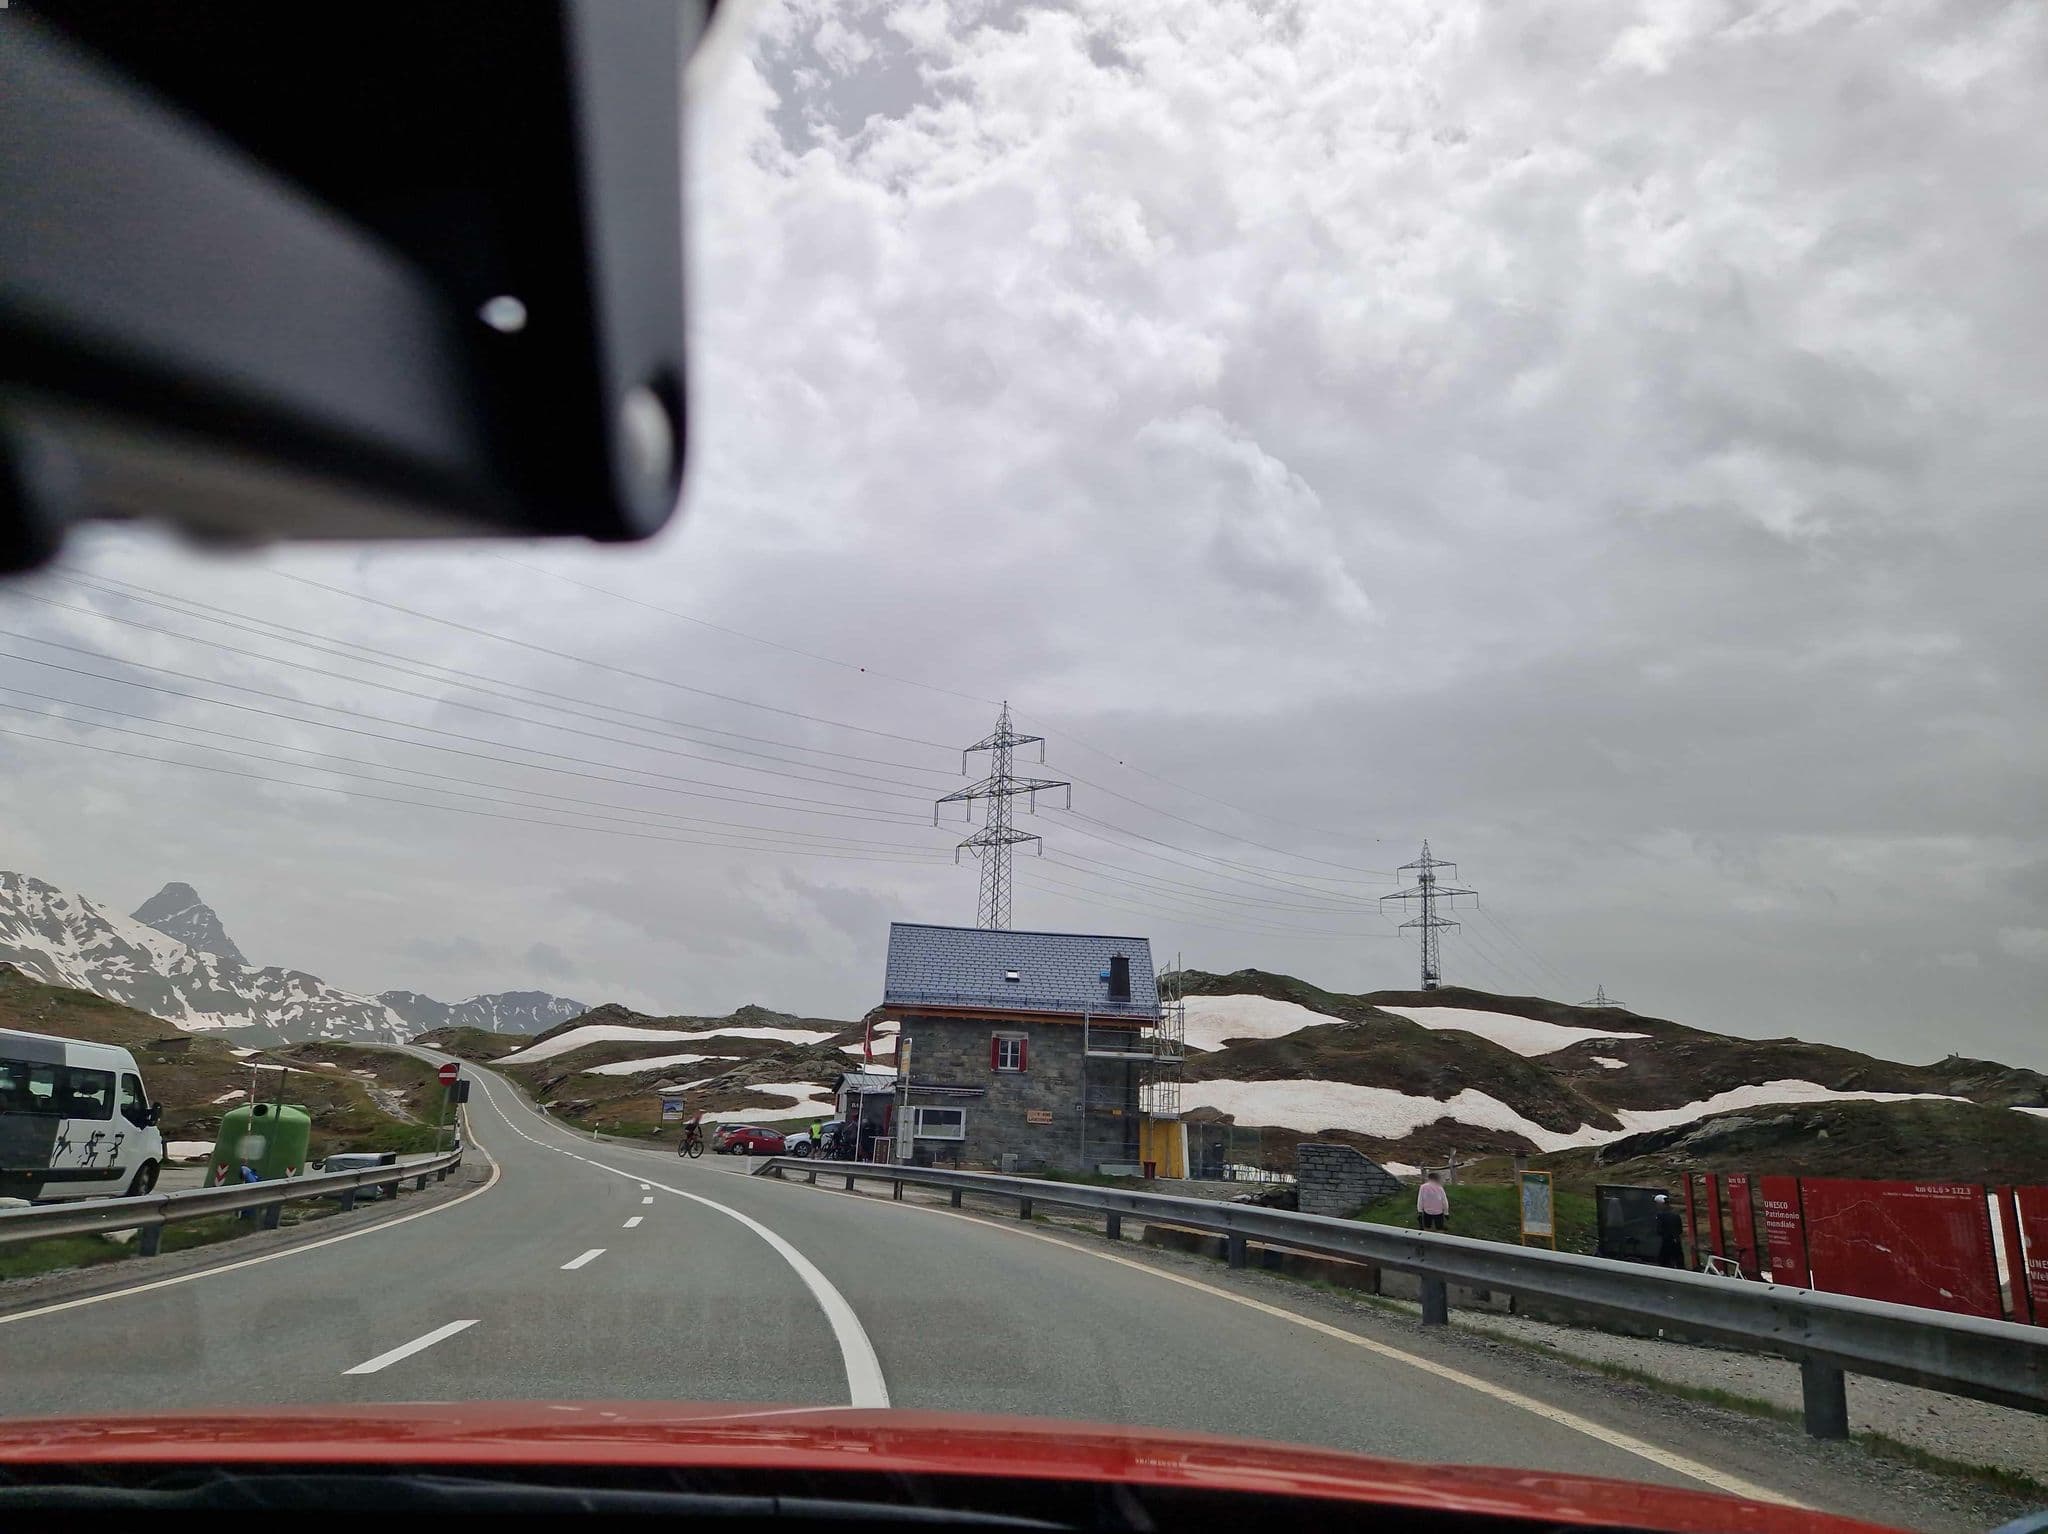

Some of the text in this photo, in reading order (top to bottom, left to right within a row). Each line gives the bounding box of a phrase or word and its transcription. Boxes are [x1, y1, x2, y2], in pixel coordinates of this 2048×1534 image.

[1764, 1201, 1788, 1209] UNESCO
[1765, 1211, 1800, 1220] Patrimonio
[1766, 1221, 1796, 1229] mondiale
